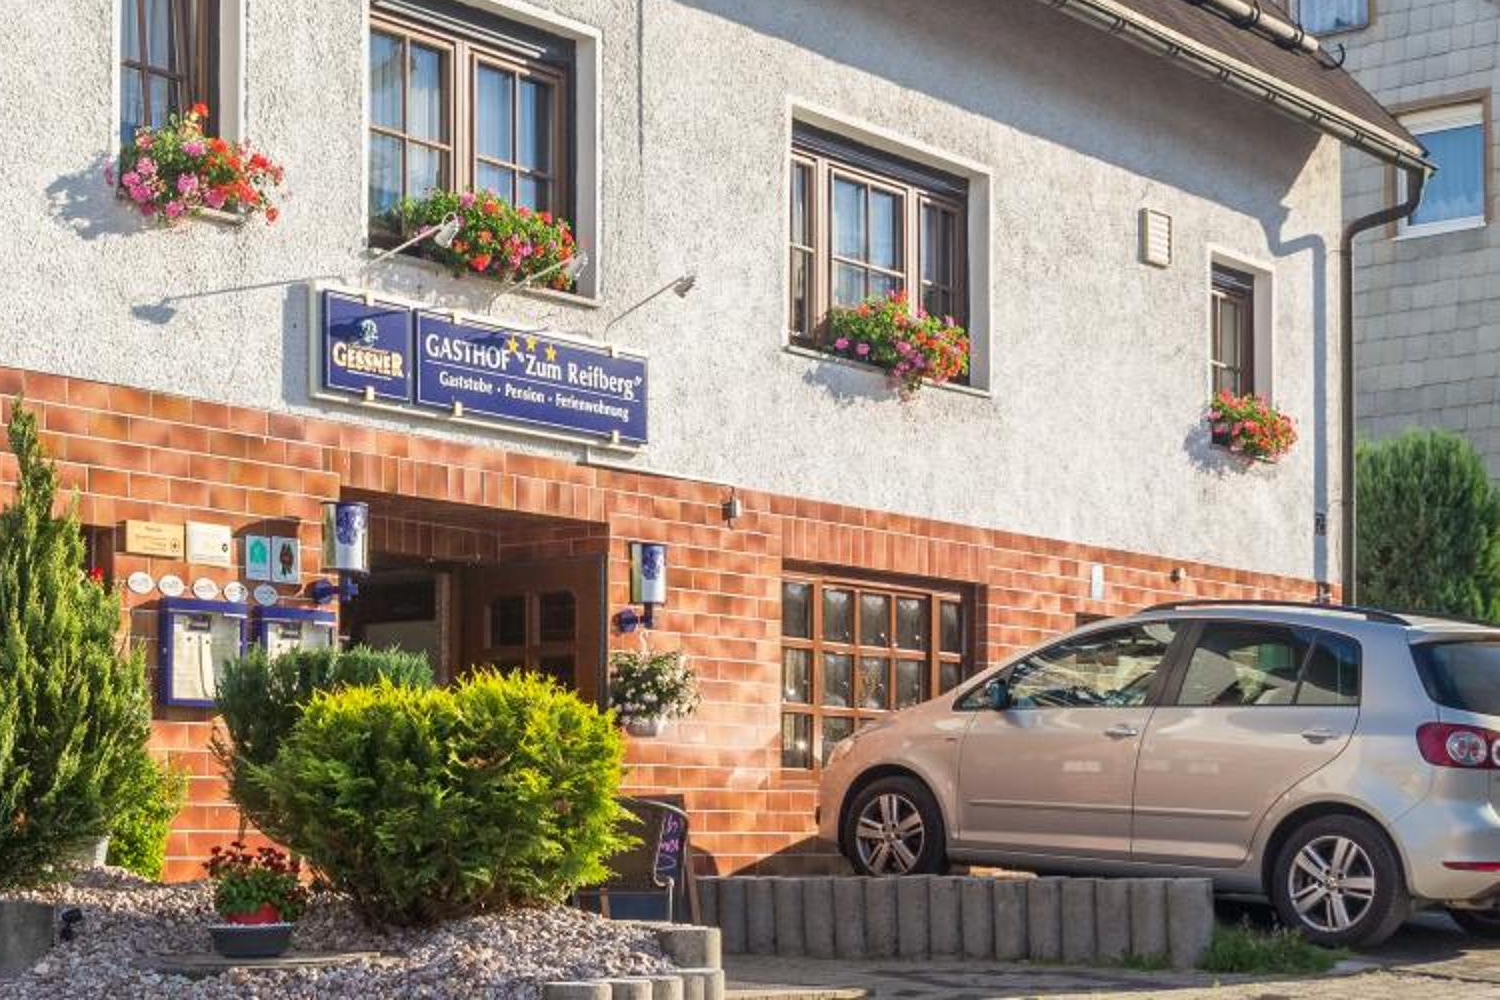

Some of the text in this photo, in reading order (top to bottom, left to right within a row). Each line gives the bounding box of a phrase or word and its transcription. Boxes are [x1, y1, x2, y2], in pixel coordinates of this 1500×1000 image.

[333, 343, 404, 377] GESSNER
[425, 333, 510, 371] GASTHOF
[439, 371, 629, 422] Gaststube Pension Ferienwohnung
